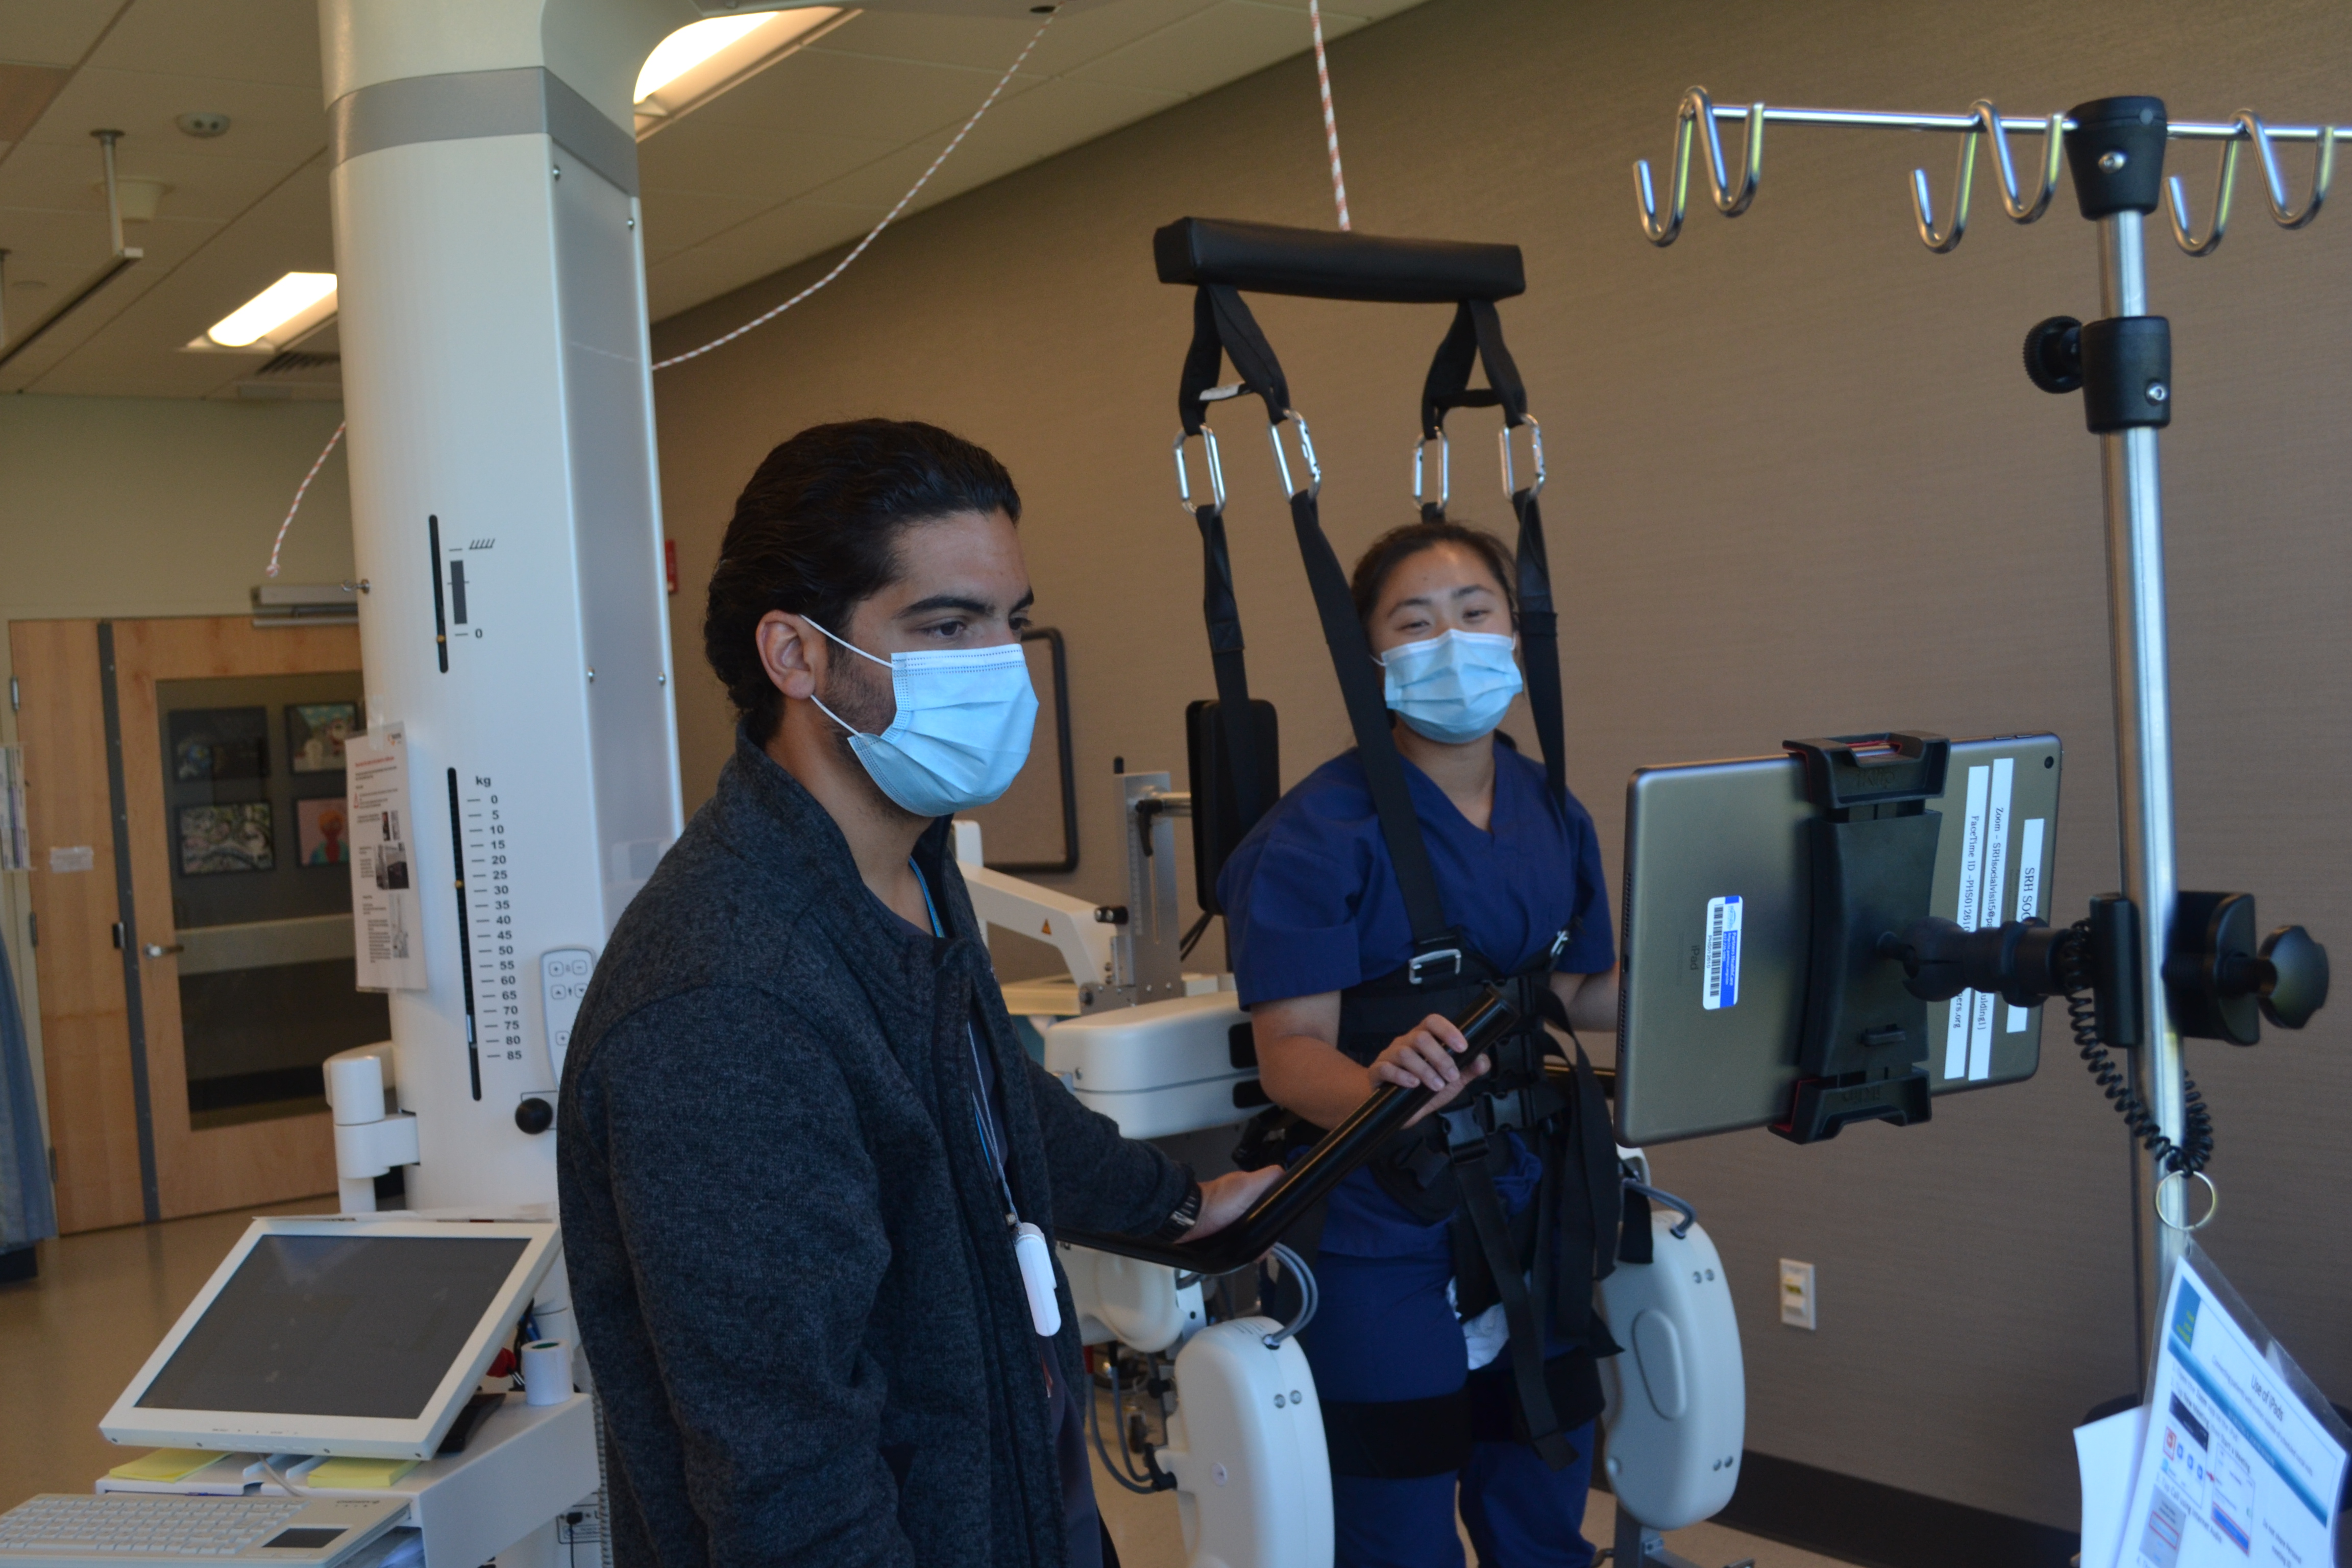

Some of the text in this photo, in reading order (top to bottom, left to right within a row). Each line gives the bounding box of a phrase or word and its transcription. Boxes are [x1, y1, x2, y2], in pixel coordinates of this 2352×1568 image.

[474, 628, 483, 639] 0
[475, 775, 492, 788] kg
[490, 794, 499, 805] 0
[492, 810, 500, 820] 5
[1994, 807, 2004, 831] Zoom
[489, 824, 504, 835] 10
[1968, 815, 1979, 857] FaceTime
[491, 840, 506, 850] 15
[492, 854, 507, 865] 20
[1967, 860, 1976, 871] ID
[493, 870, 508, 880] 25
[2023, 867, 2035, 892] SRH
[494, 885, 509, 895] 30
[495, 900, 510, 910] 35
[496, 915, 511, 925] 40
[497, 930, 512, 940] 45
[499, 945, 513, 955] 50
[1689, 945, 1700, 970] iPad
[500, 960, 515, 970] 55
[500, 975, 516, 985] 60
[502, 990, 517, 1000] 65
[503, 1005, 519, 1015] 70
[504, 1020, 520, 1030] 75
[506, 1035, 521, 1045] 80
[507, 1050, 522, 1060] 85
[2250, 1373, 2284, 1423] Use of iPads
